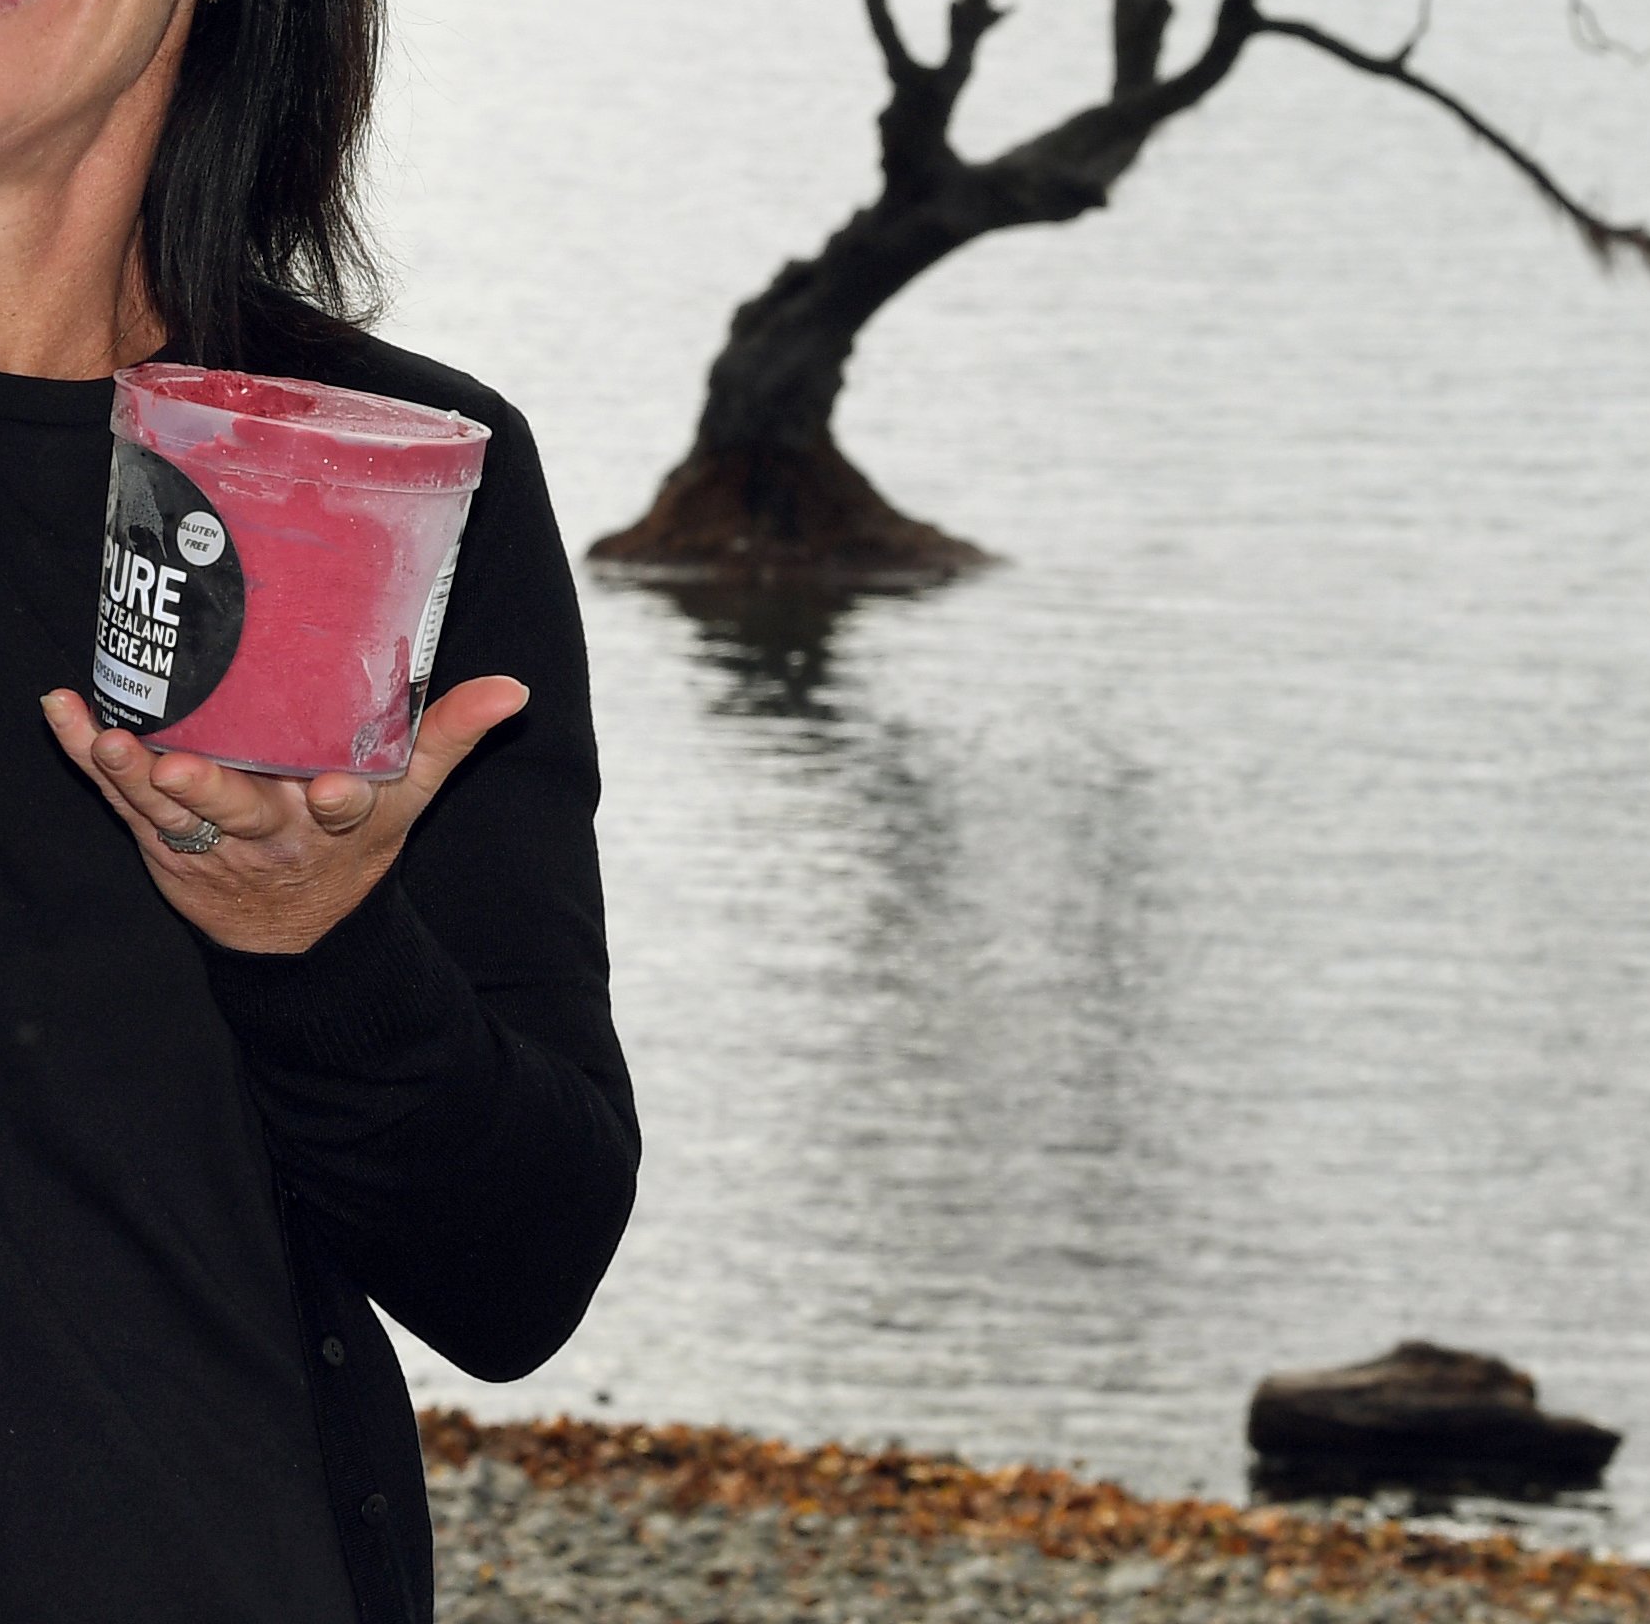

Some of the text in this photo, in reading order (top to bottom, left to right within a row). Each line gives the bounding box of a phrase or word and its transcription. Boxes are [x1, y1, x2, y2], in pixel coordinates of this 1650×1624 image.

[179, 521, 218, 538] GLUTEN
[184, 538, 210, 552] FREE
[101, 534, 187, 627] PURE
[100, 593, 178, 648] EW ZEALAND
[108, 627, 174, 677] CREAM
[95, 656, 152, 700] OYSENBERRY
